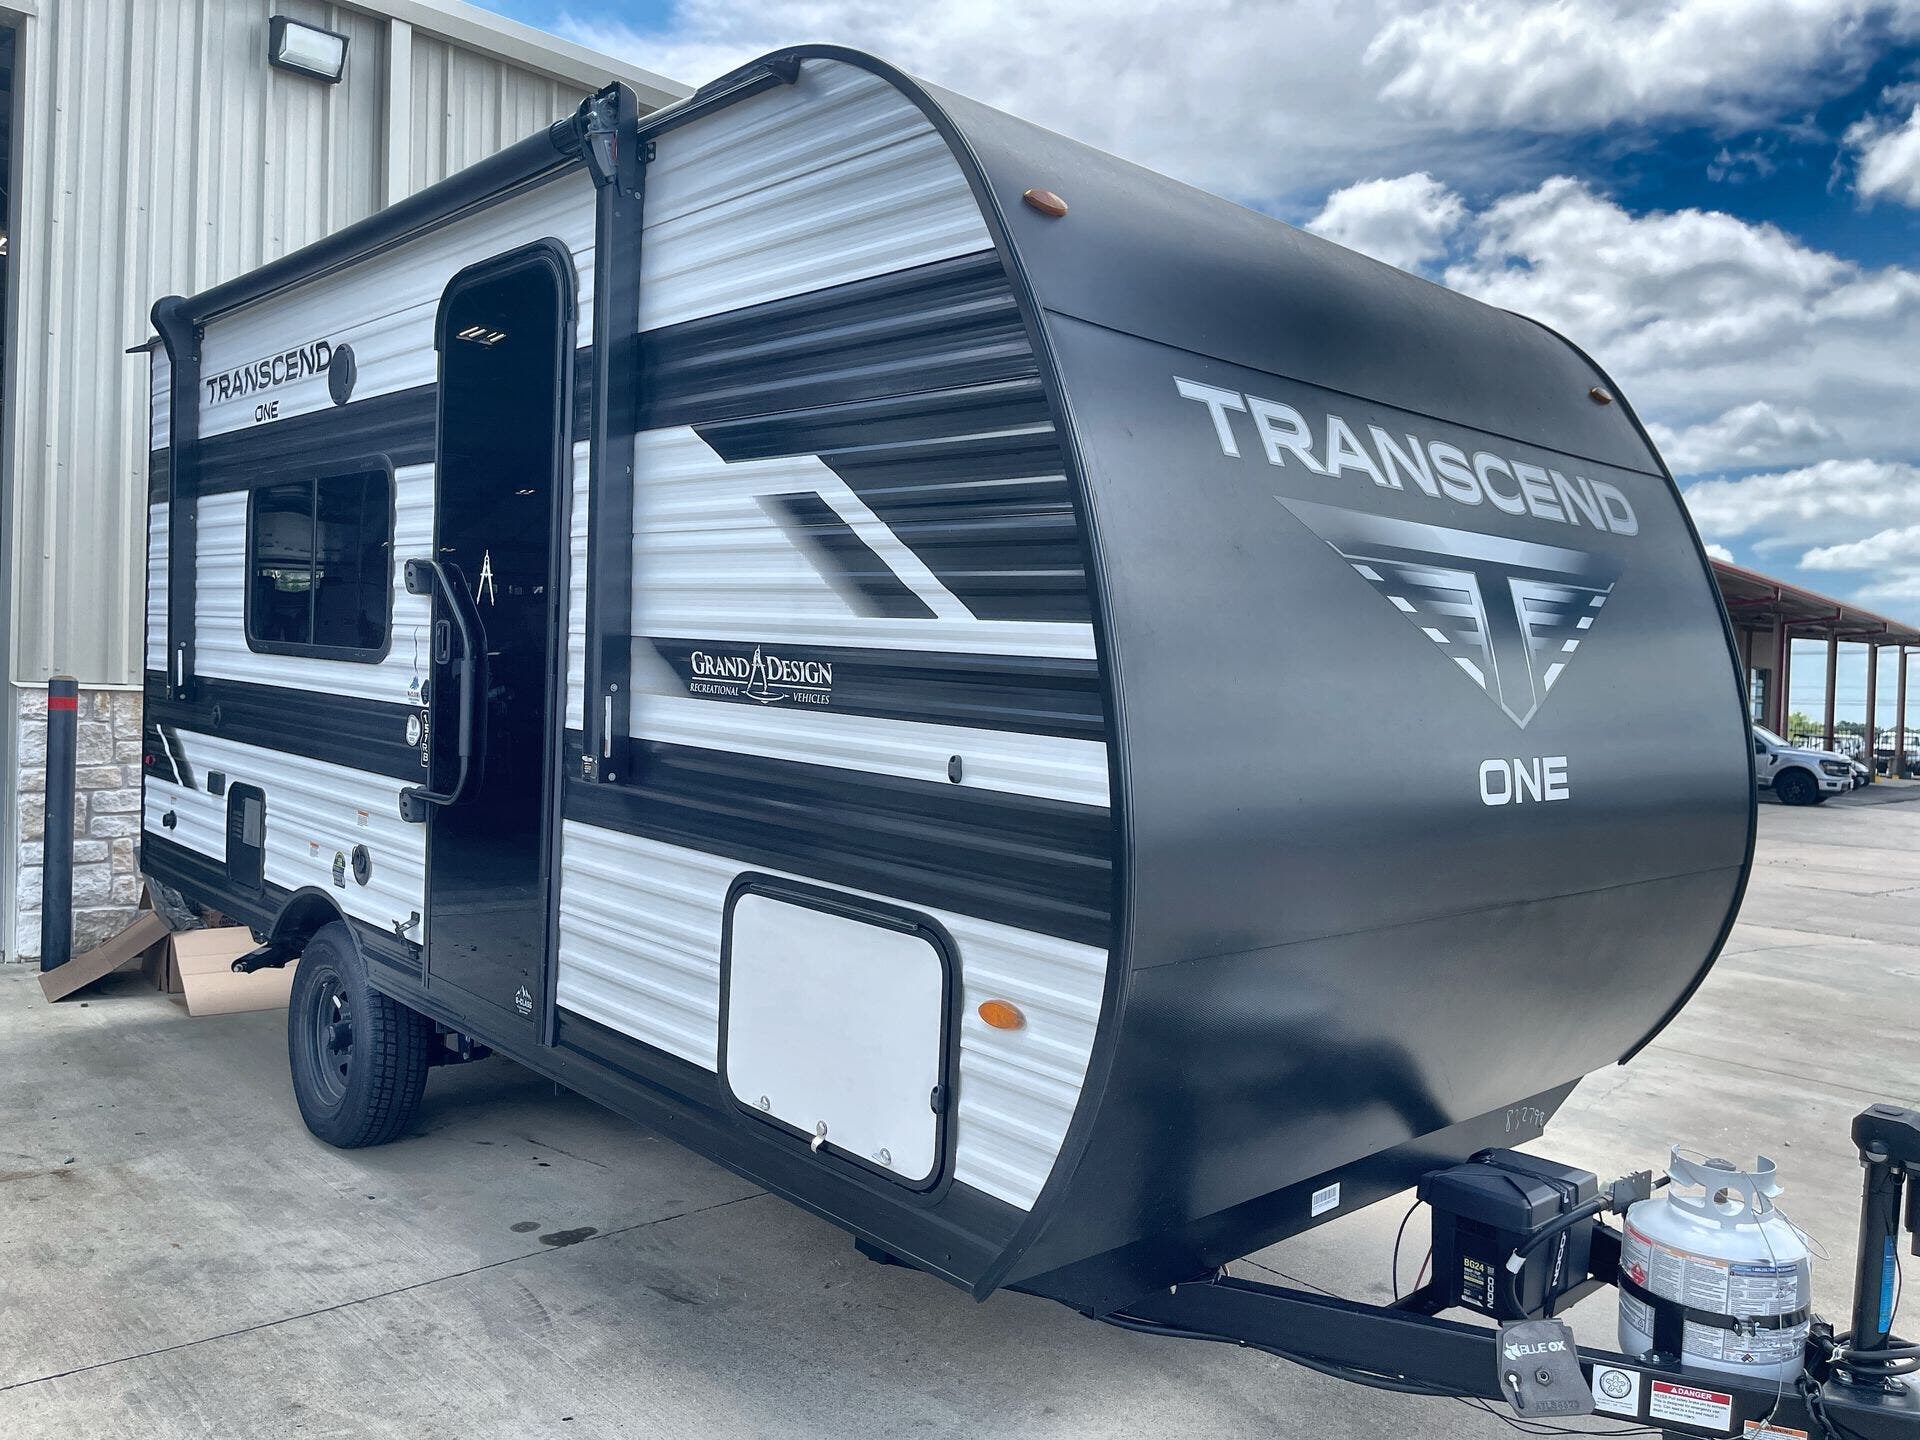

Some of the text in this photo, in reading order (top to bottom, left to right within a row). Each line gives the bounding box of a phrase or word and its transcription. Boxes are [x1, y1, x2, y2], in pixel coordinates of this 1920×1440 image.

[207, 341, 332, 405] TRANSCEND
[255, 400, 279, 422] ONE
[1173, 376, 1639, 536] TRANSCEND
[691, 651, 832, 685] GRAND DESIGN
[690, 683, 830, 705] RECREATIONAL VEHICLES
[1480, 756, 1570, 806] ONE
[1464, 1258, 1484, 1272] BG24
[1552, 1232, 1567, 1286] NOCO
[1487, 1276, 1495, 1309] NOCO
[1520, 1341, 1566, 1355] BLUE OX
[1679, 1388, 1712, 1400] DANGER
